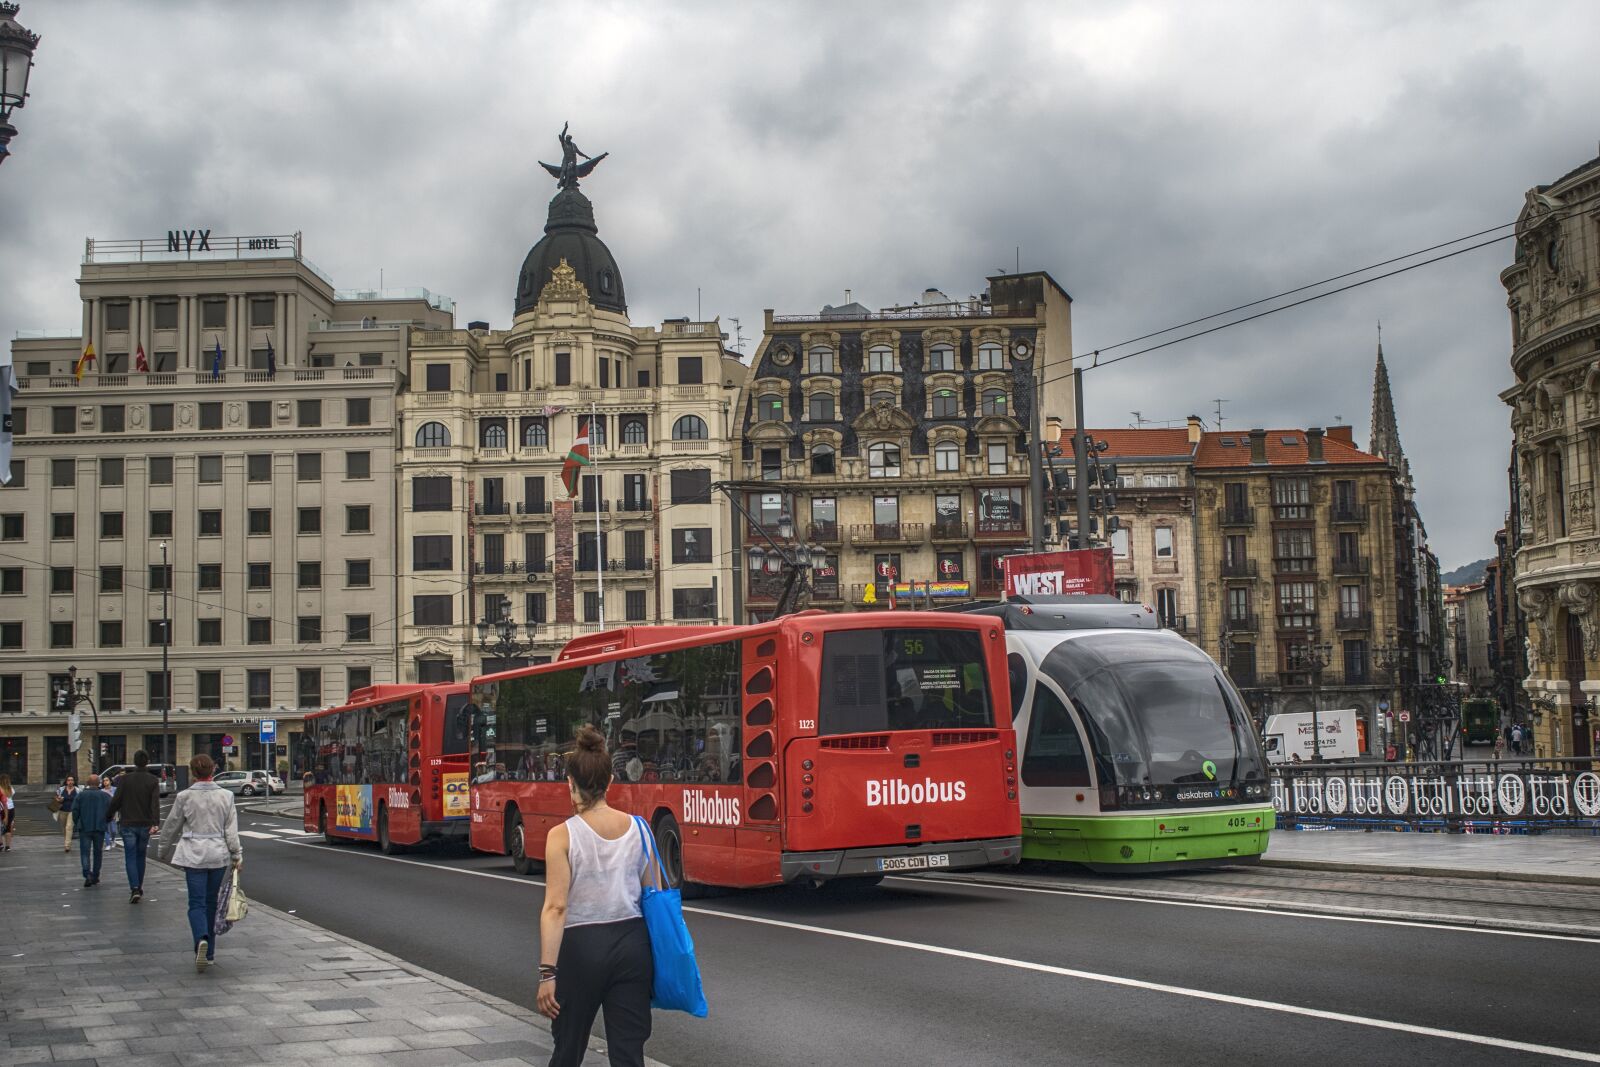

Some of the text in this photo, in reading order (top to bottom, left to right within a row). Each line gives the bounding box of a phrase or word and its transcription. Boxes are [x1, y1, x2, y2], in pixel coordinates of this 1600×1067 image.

[168, 229, 280, 252] NYX HOTEL
[1013, 571, 1064, 595] WEST
[904, 639, 924, 655] 56
[232, 716, 247, 724] NYX
[799, 719, 815, 729] 1123
[446, 783, 469, 793] OC
[866, 777, 967, 807] Bilbobus
[1177, 790, 1213, 800] euskotren
[388, 787, 409, 808] Bilbobus
[683, 789, 740, 826] Bilbobus
[1228, 817, 1246, 828] 405
[883, 855, 947, 869] 5005 CDW SP
